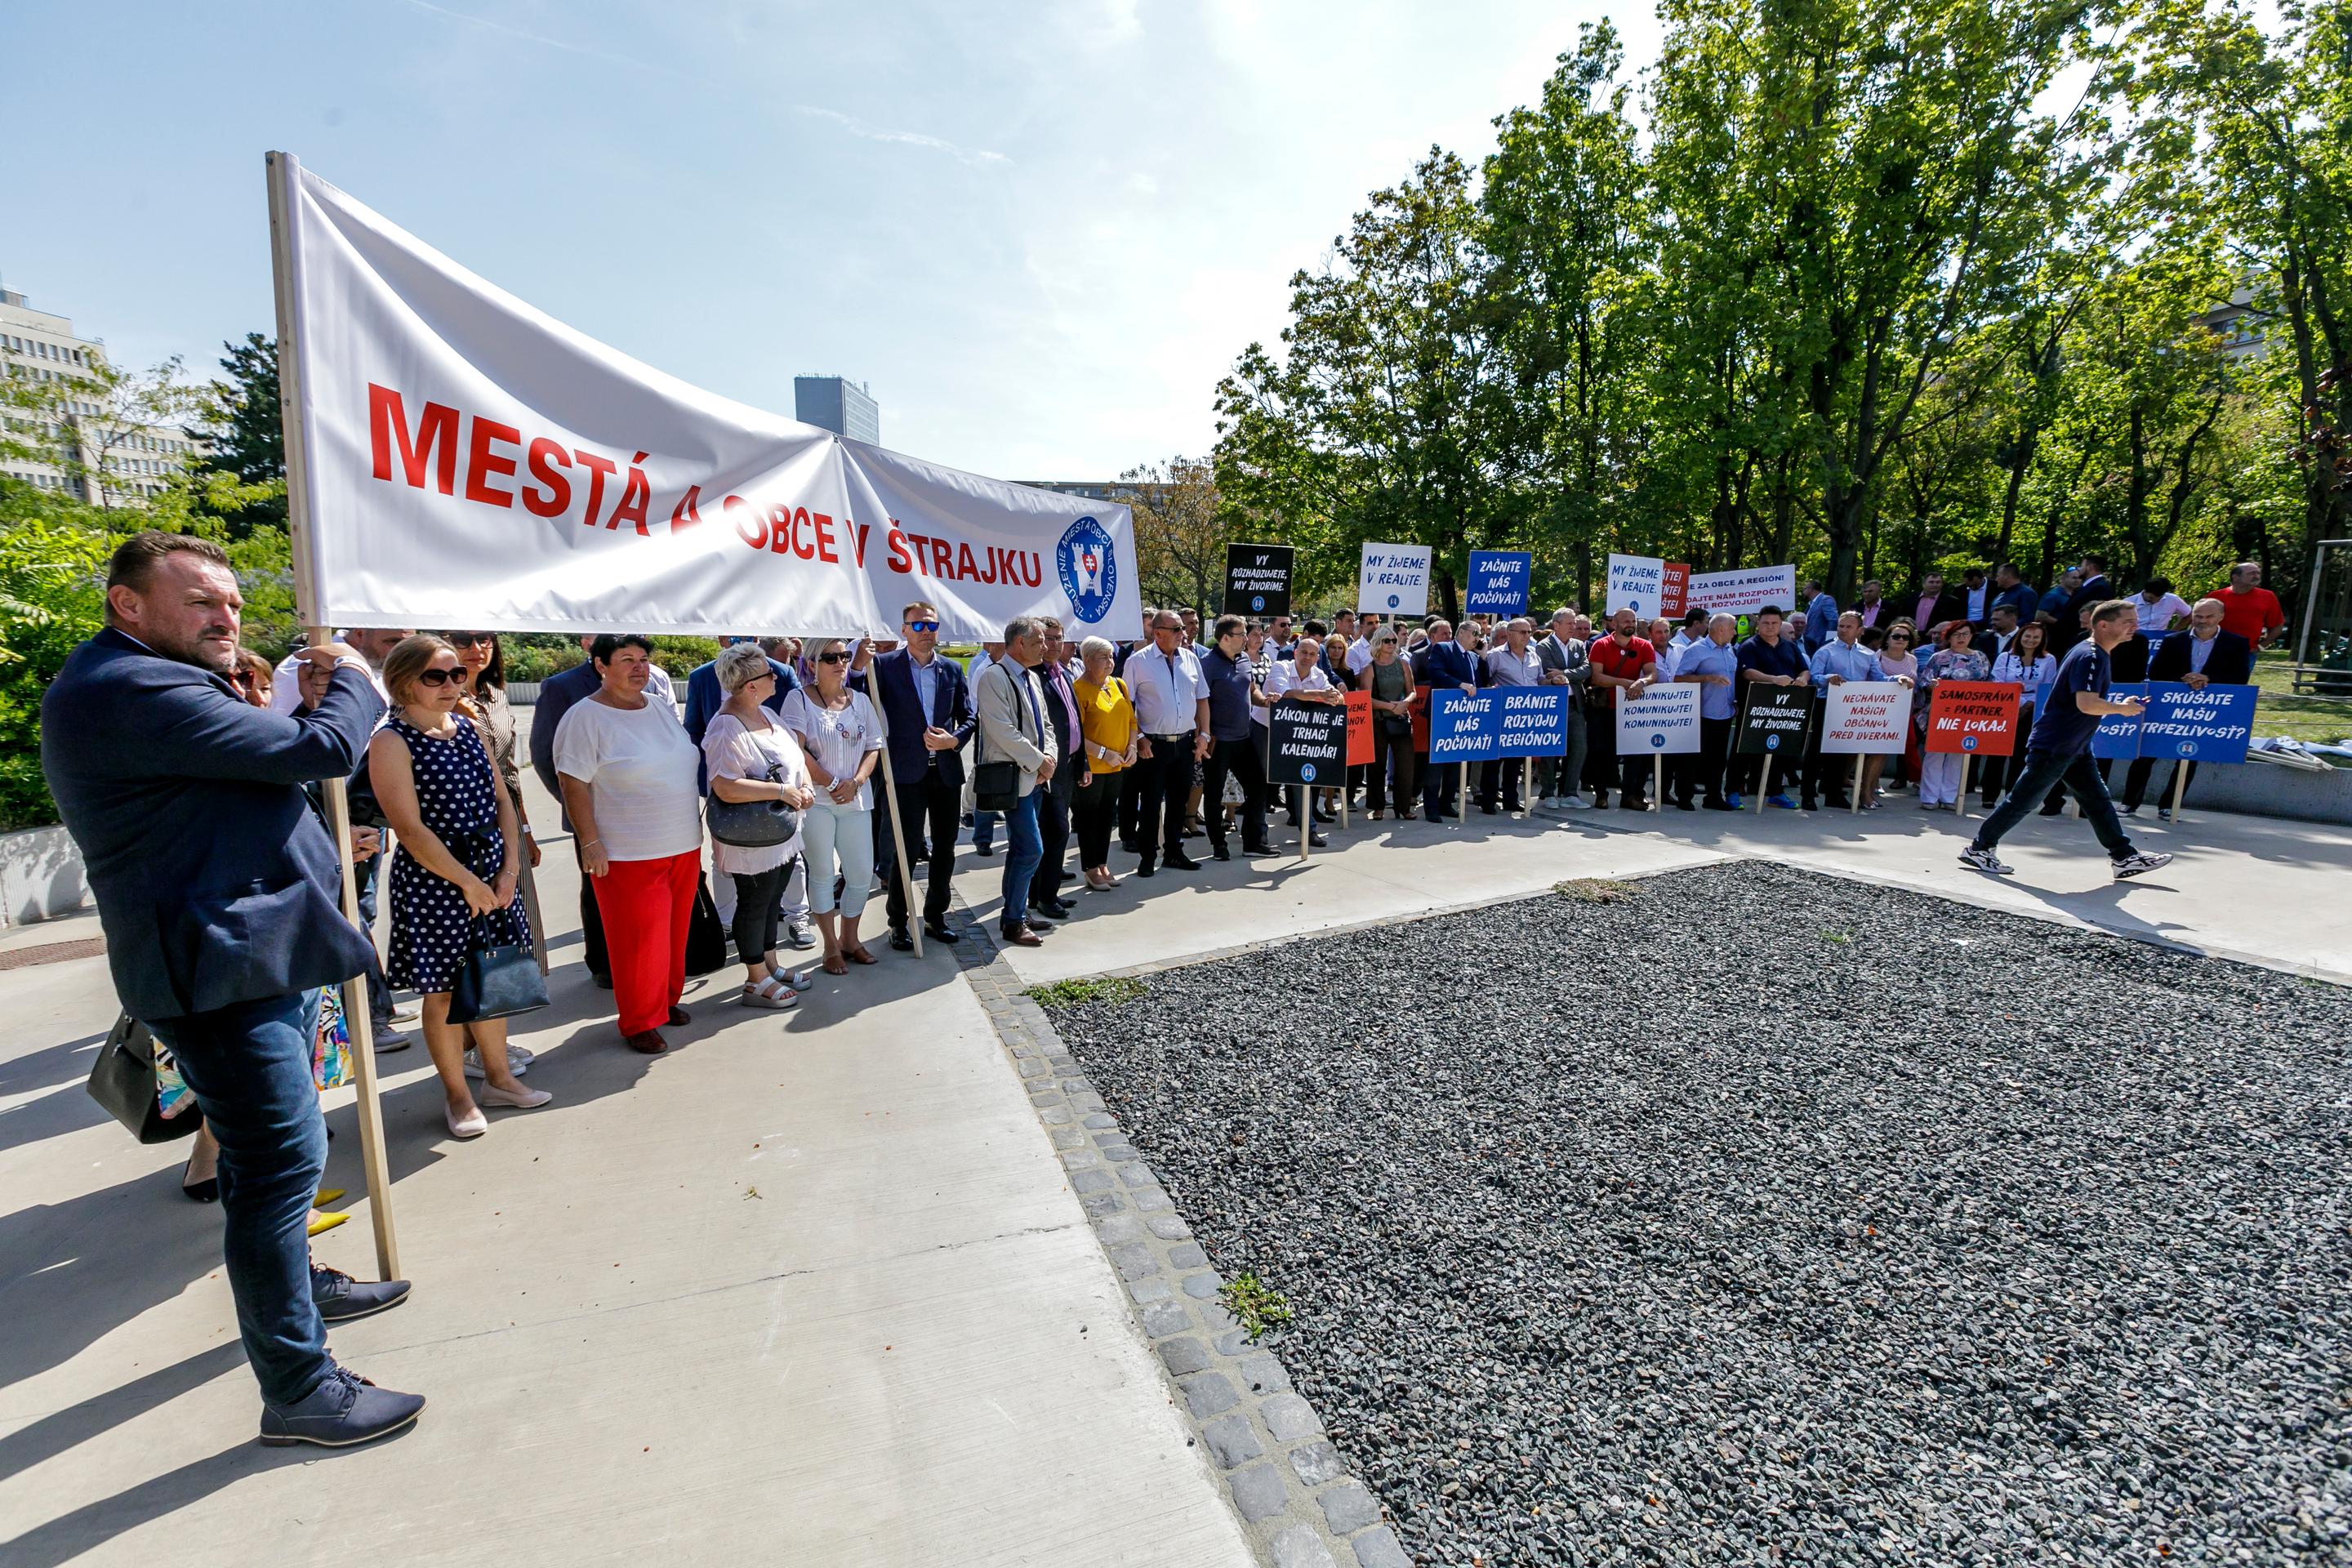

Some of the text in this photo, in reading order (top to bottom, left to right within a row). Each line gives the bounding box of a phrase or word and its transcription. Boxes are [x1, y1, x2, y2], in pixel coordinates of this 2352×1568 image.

[368, 382, 1042, 587] MESTÁ A OBCE V ŠTRAJKU
[1256, 555, 1269, 566] VY
[1366, 555, 1426, 568] MY ŽIJEME
[1479, 558, 1522, 572] ZAČNITE
[1062, 521, 1085, 547] MIEST
[1085, 521, 1090, 531] A
[1095, 549, 1115, 617] SLOVENSKA
[1232, 568, 1287, 580] ROZHADZUJETE,
[1612, 565, 1659, 579] MY ŽIJEME
[1233, 580, 1284, 591] MY ŽIVORÍME.
[1367, 572, 1422, 586] V REALITE.
[1488, 575, 1511, 589] NÁS
[1712, 579, 1735, 588] OBCE
[1746, 575, 1784, 584] REGIÓN!
[1613, 580, 1656, 594] V REALITE.
[1470, 590, 1521, 605] POČÚVAŤ!
[1686, 587, 1788, 603] DAJTE NÁM ROZPOČTY,
[1712, 599, 1761, 608] ROZVOJU!!!
[1504, 693, 1557, 709] BRÁNITE
[1624, 690, 1693, 702] KMUNIKUJTE!
[1775, 694, 1790, 705] VY
[1842, 693, 1897, 703] NECHÁVATE
[1939, 690, 2014, 702] SAMOSPRÁVA
[2161, 691, 2234, 705] SKÚŠATE
[1444, 697, 1491, 714] ZAČNITE
[1624, 704, 1693, 715] KOMUNIKUJTE!
[1750, 706, 1806, 719] ROZHADZUJETE,
[1851, 706, 1886, 715] NAŠICH
[1954, 705, 2004, 716] PARTNER.
[1274, 706, 1344, 726] ZÁKON NIE JE
[1503, 714, 1558, 728] ROZVOJU
[2172, 707, 2216, 721] NAŠU
[1454, 715, 1480, 732] NÁS
[1624, 718, 1693, 729] KOMUNIKUJTE!
[1750, 719, 1802, 730] MY ŽIVORÍME.
[1936, 718, 2007, 732] NIE LOKAJ.
[2141, 722, 2246, 739] TRPEZLIVOSŤ?
[1293, 727, 1330, 741] TRHACÍ
[1499, 730, 1561, 747] REGIÓNOV.
[1829, 731, 1900, 741] PRED DVERAMI.
[1435, 733, 1492, 752] POČÚVAŤ!
[1281, 743, 1337, 760] KALENDÁR!
